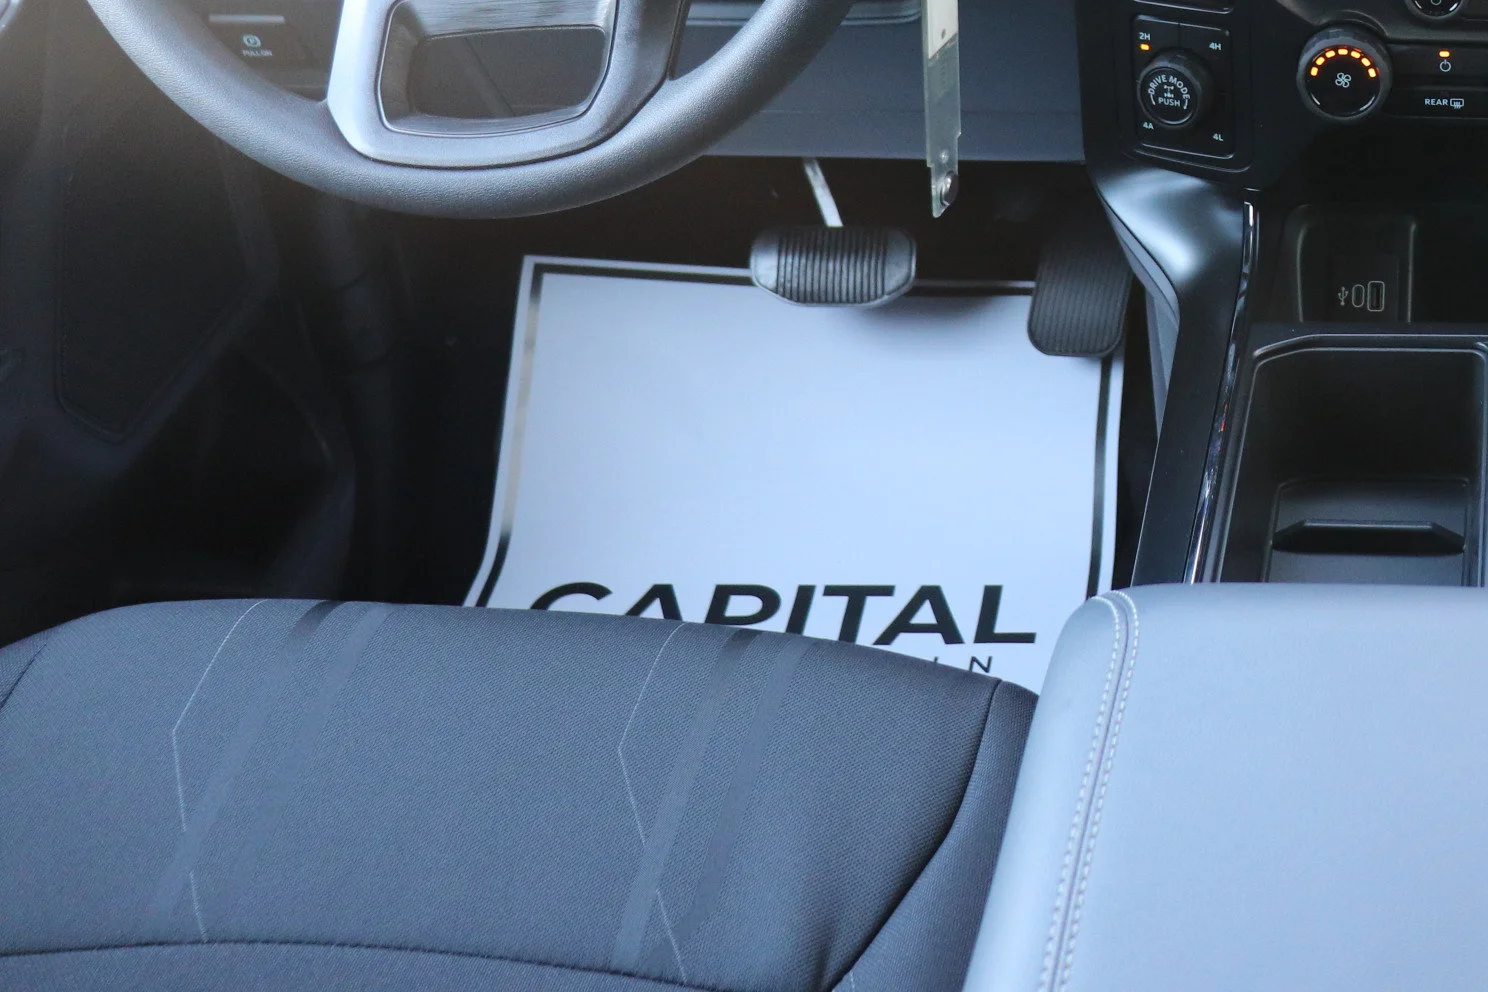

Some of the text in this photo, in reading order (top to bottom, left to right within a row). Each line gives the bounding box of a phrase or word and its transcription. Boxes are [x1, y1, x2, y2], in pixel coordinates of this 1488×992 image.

[1139, 32, 1151, 41] 2H
[1209, 42, 1222, 51] 4H
[1148, 74, 1191, 100] DRIVE MODE
[1158, 97, 1181, 108] PUSH
[1425, 98, 1449, 107] REAR
[1143, 122, 1154, 130] 4A
[1212, 133, 1224, 141] 4L
